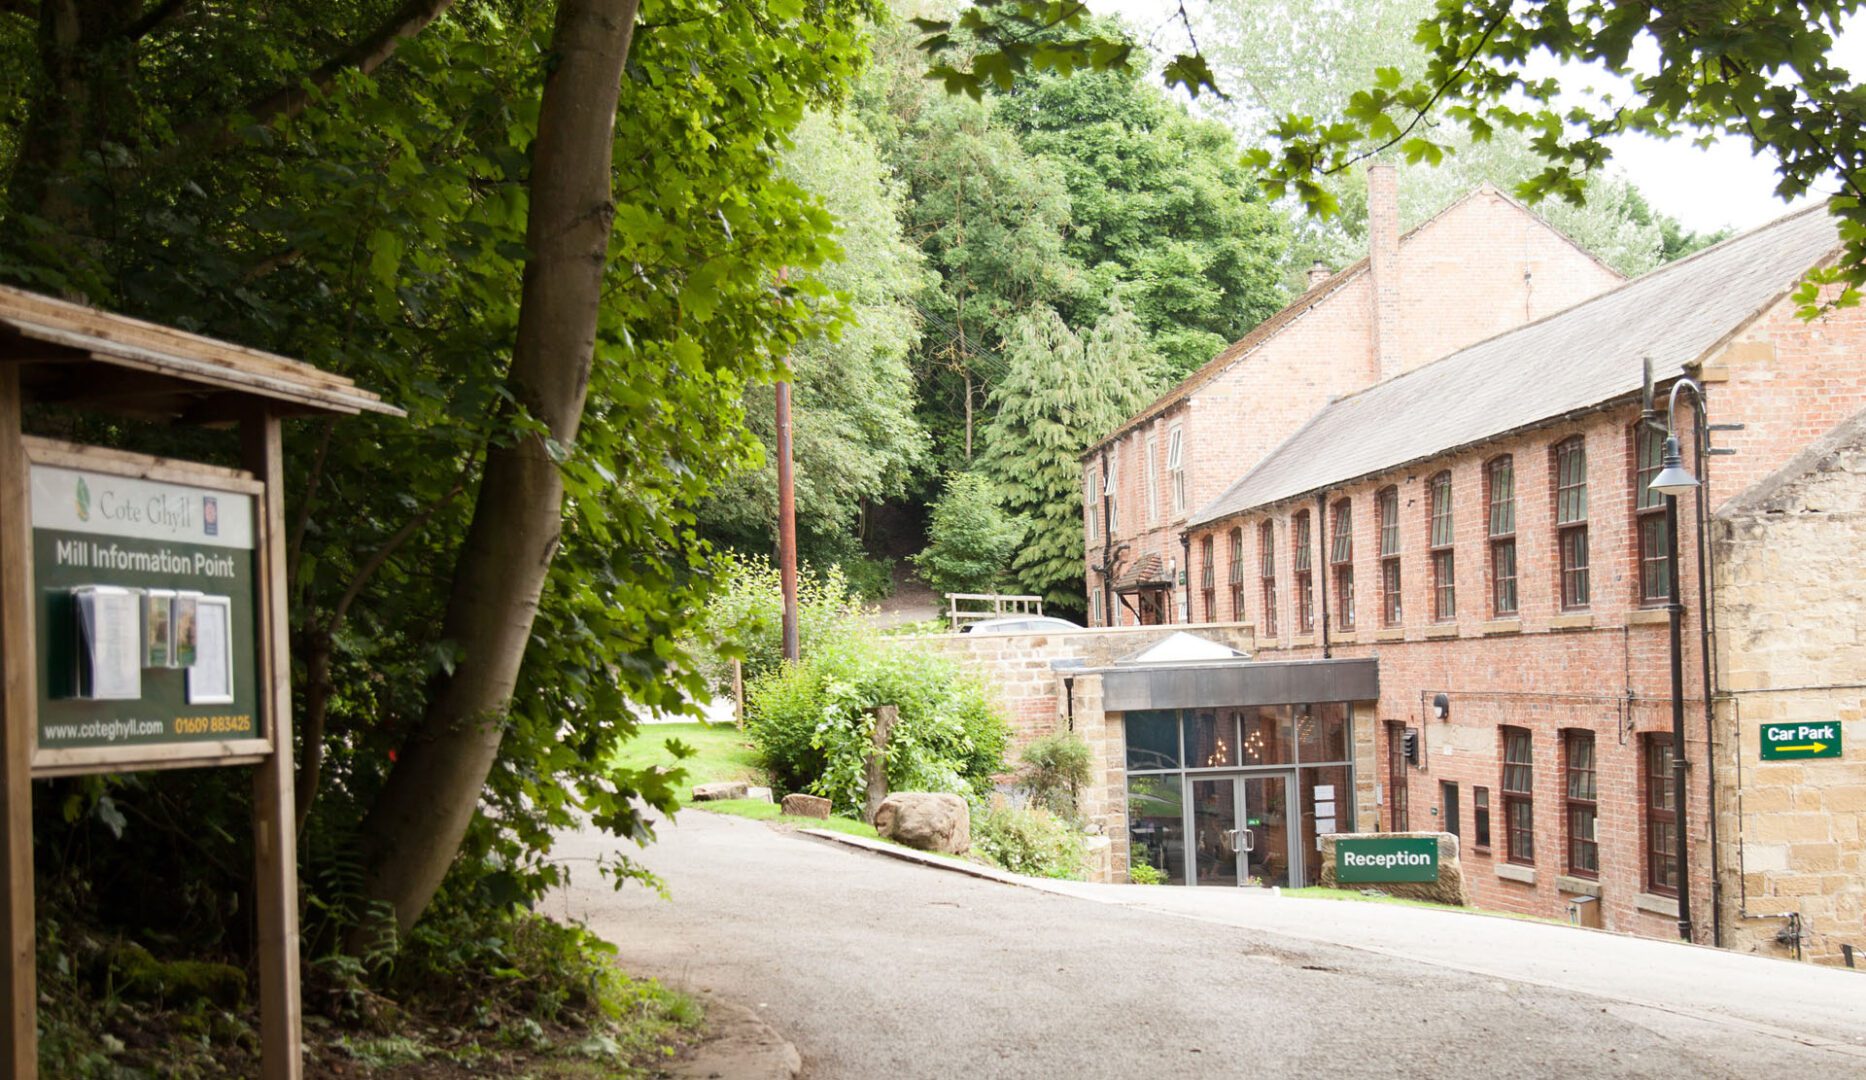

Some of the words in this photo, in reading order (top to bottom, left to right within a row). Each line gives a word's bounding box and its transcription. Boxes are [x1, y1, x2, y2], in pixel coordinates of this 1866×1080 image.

[100, 490, 141, 522] Cote
[147, 494, 191, 532] Ghyll
[57, 539, 88, 567] Mill
[93, 543, 191, 575] Information
[195, 552, 235, 578] Point
[44, 719, 163, 741] www.coteghyll.com
[175, 717, 209, 734] 01609
[210, 715, 250, 732] 883425
[1768, 727, 1796, 741] Car
[1798, 725, 1834, 740] Park
[1344, 851, 1431, 869] Reception
